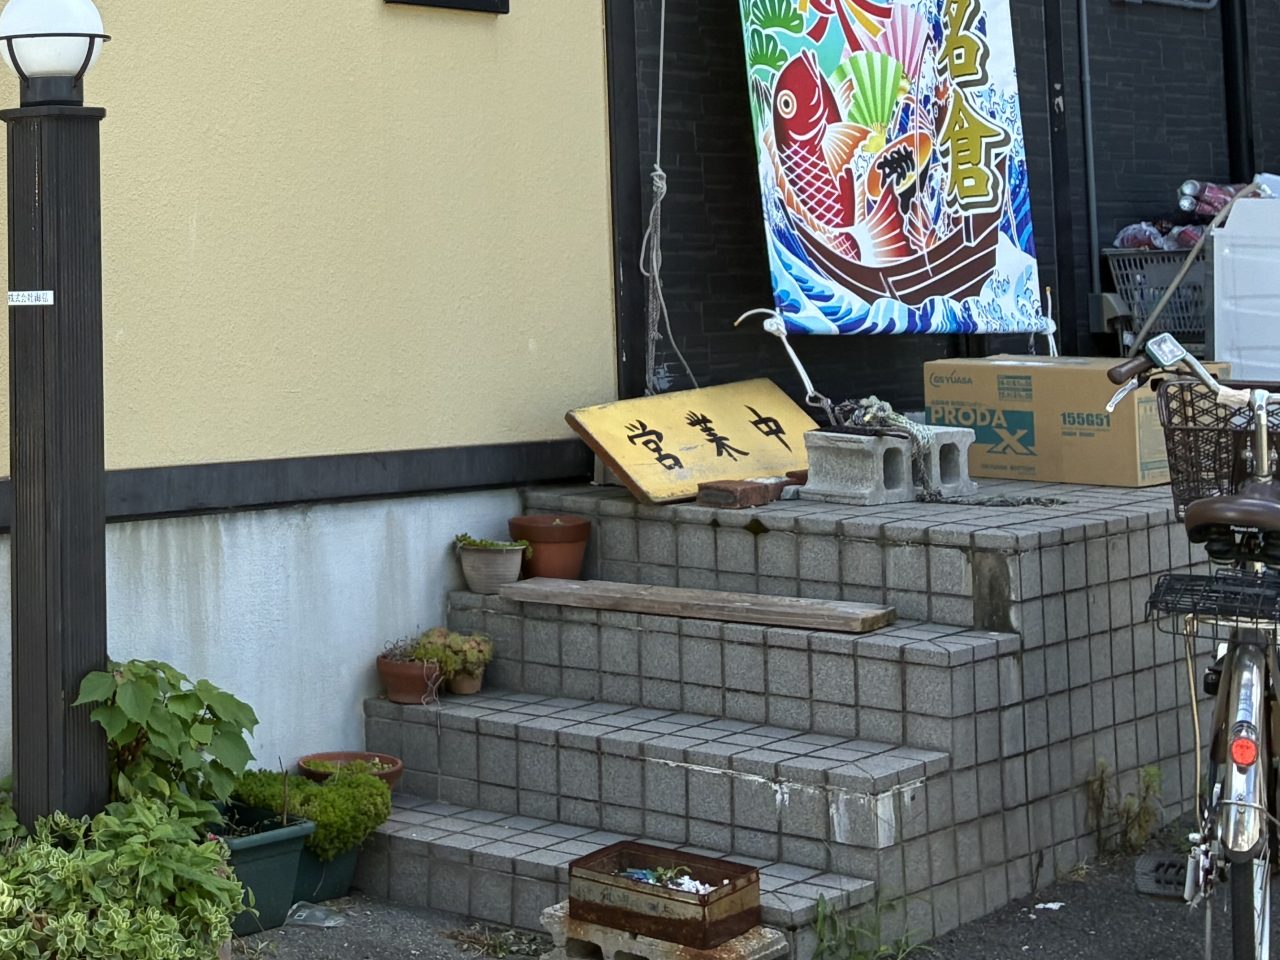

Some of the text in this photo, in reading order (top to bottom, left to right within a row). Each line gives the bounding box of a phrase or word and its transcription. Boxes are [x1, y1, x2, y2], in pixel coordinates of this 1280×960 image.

[930, 406, 1007, 427] PRODA
[1060, 411, 1111, 428] 155G51
[624, 404, 793, 471] 営業中
